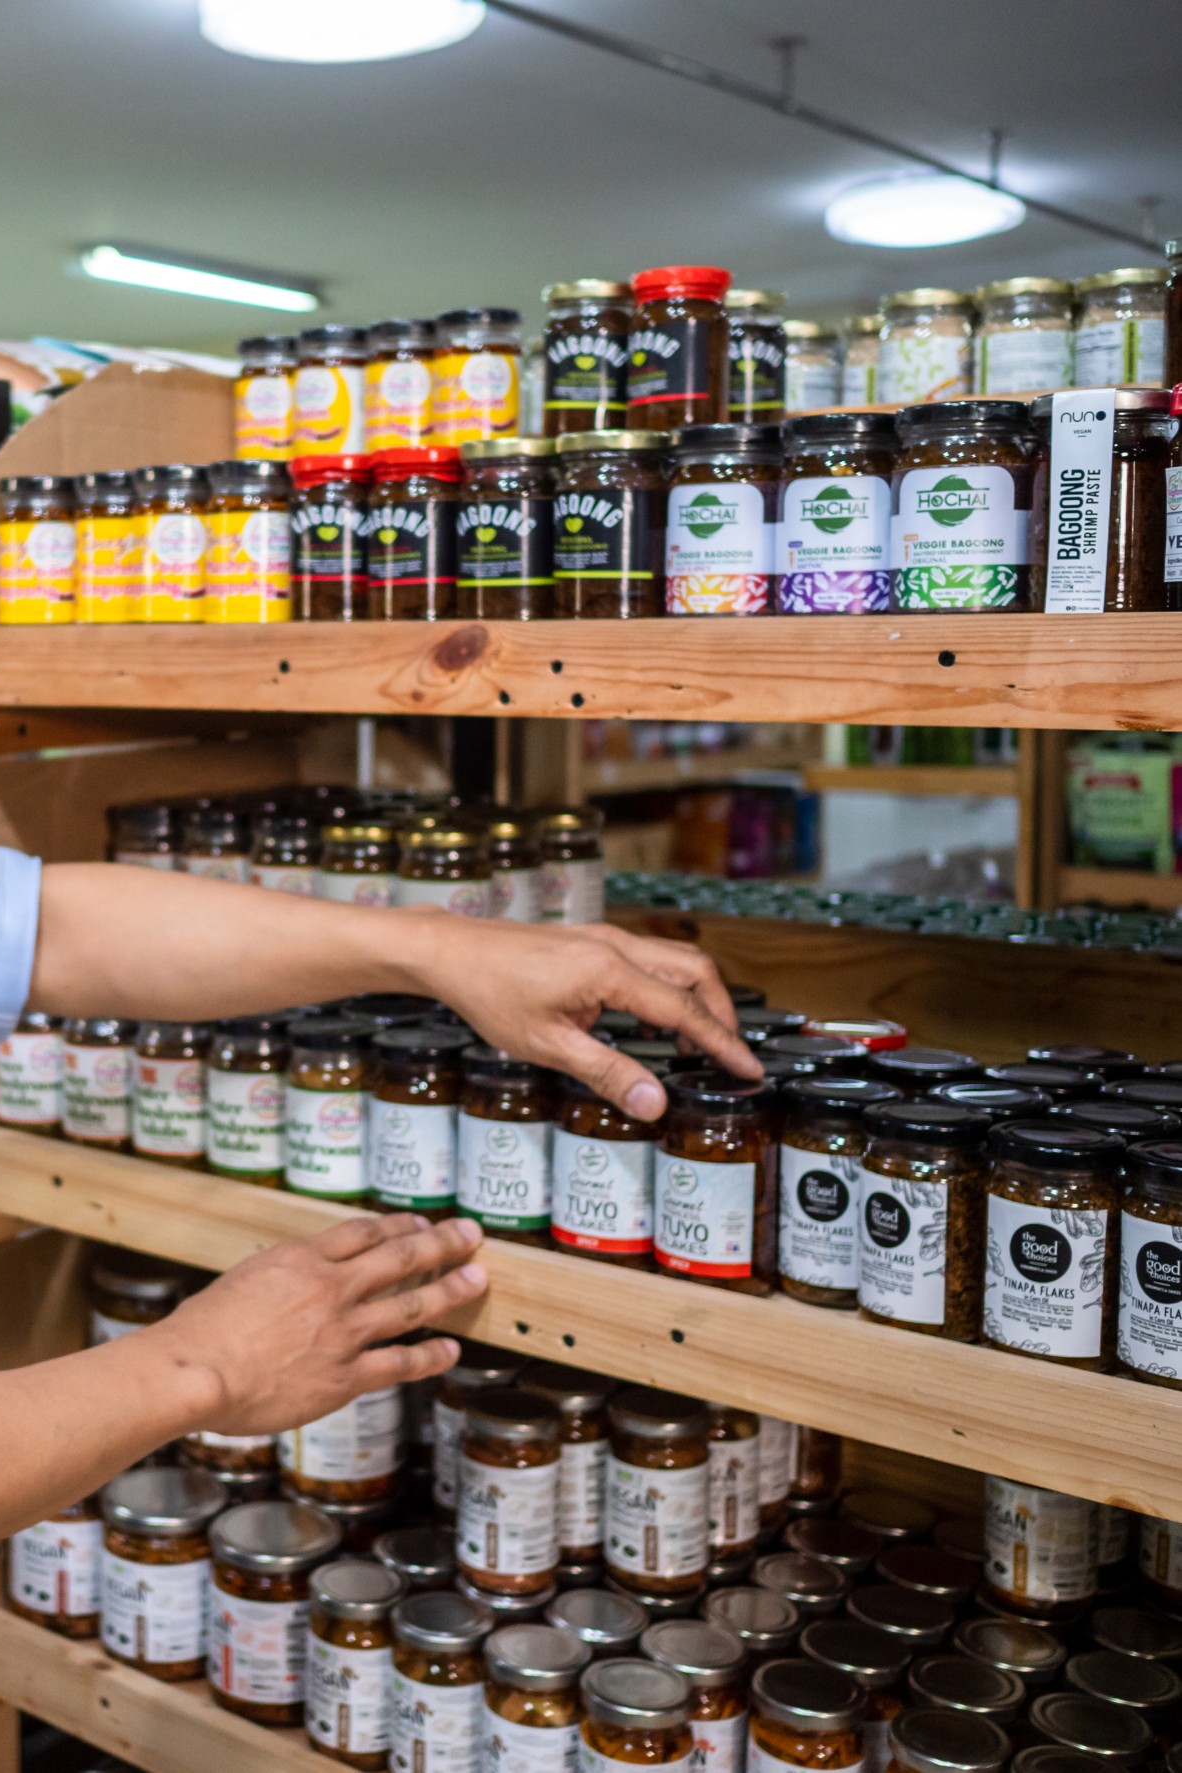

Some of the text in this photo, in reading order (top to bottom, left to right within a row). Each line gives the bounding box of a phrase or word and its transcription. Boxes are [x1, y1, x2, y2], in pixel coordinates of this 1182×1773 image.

[1057, 468, 1085, 560] BAGOONG
[1083, 469, 1101, 554] SHRIMP PASTE
[913, 538, 1005, 550] VEGGIE BAGOONG
[478, 1176, 529, 1198] TUYO
[567, 1193, 618, 1219] TUYO
[565, 1214, 617, 1233] FLAKES
[661, 1213, 709, 1243] TUYO
[823, 1226, 854, 1237] FLAKES
[659, 1232, 708, 1256] FLAKES
[1022, 1231, 1036, 1242] the
[1022, 1241, 1058, 1257] good
[1146, 1250, 1159, 1260] the
[884, 1252, 915, 1266] FLAKES
[1146, 1260, 1181, 1276] good
[1150, 1270, 1181, 1283] choices
[1004, 1277, 1075, 1300] TINAPA FLAKES
[1131, 1296, 1161, 1316] TINAPA
